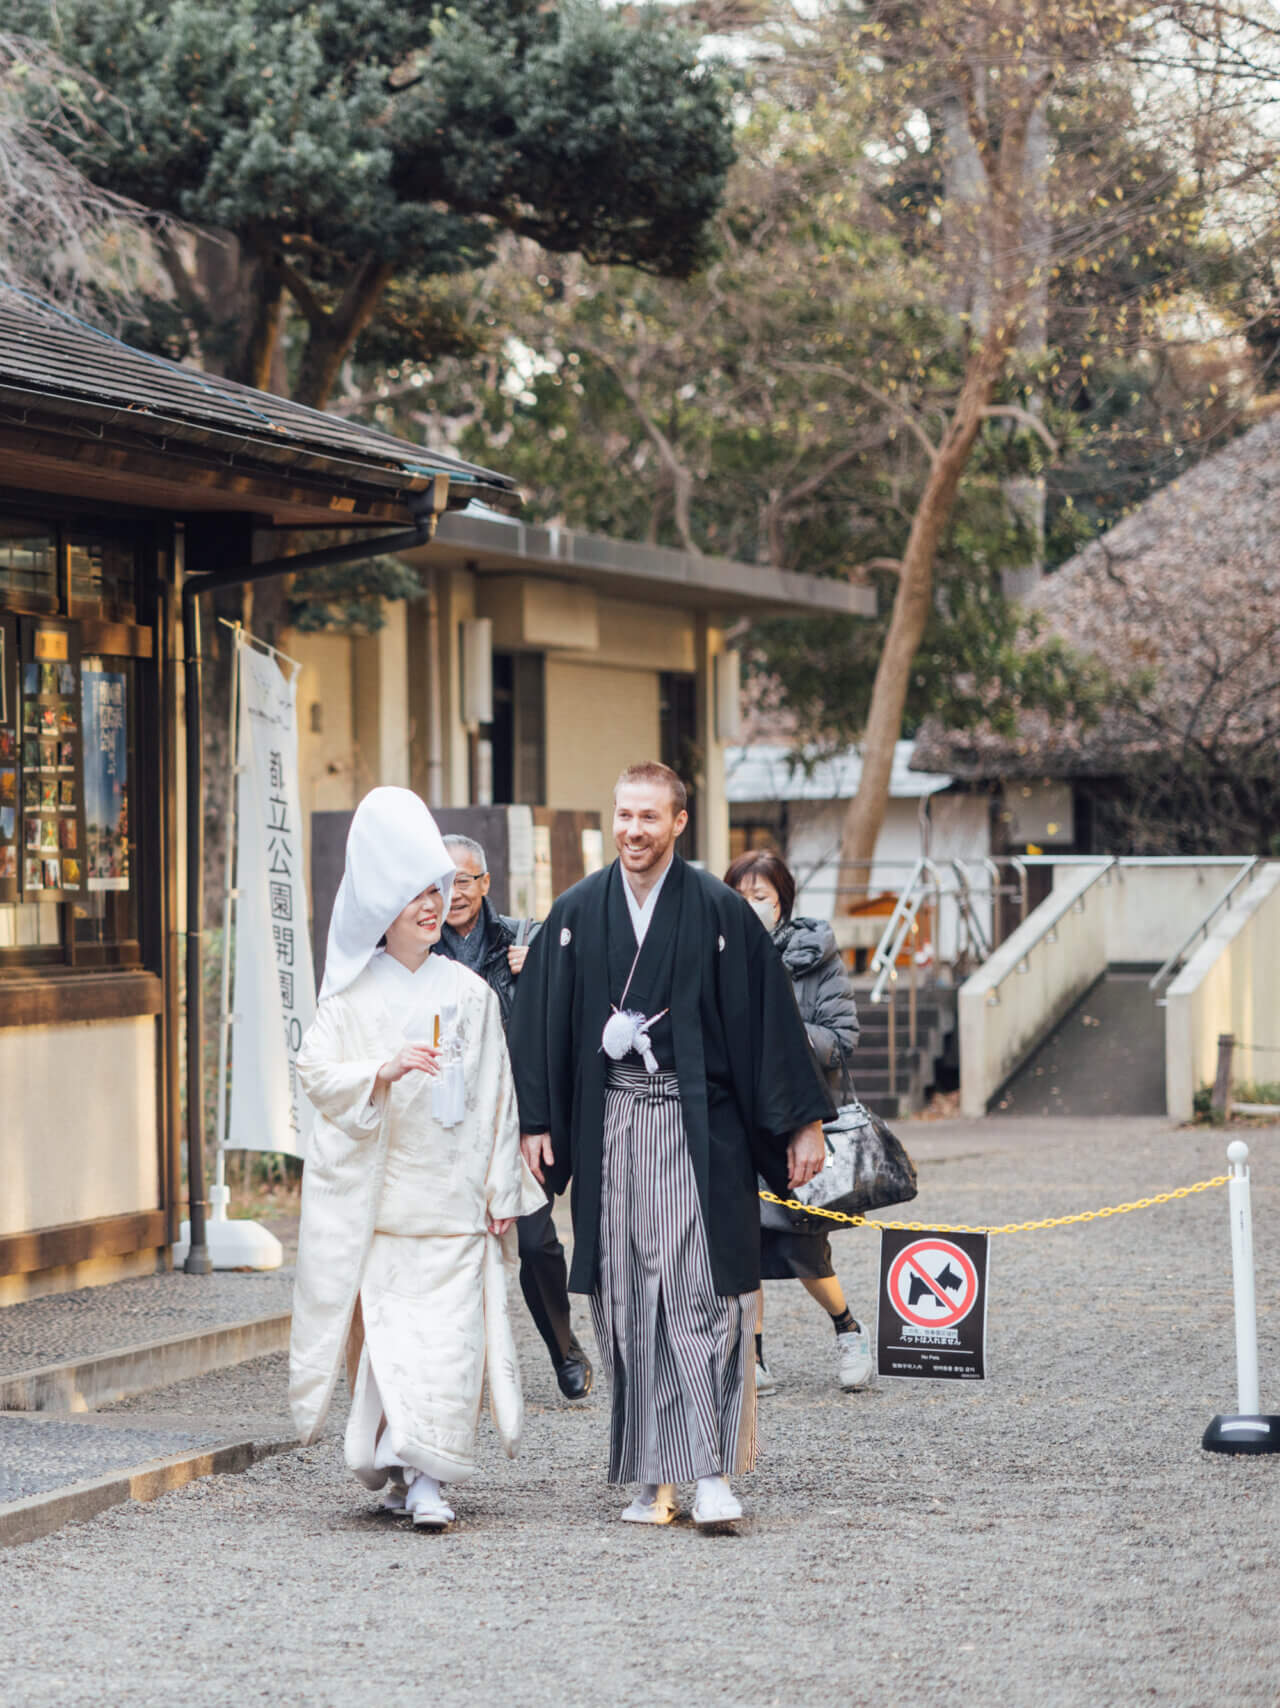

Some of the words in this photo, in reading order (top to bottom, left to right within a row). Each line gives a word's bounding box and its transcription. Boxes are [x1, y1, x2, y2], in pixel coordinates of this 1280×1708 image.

[899, 1335, 962, 1346] ペットは入れません
